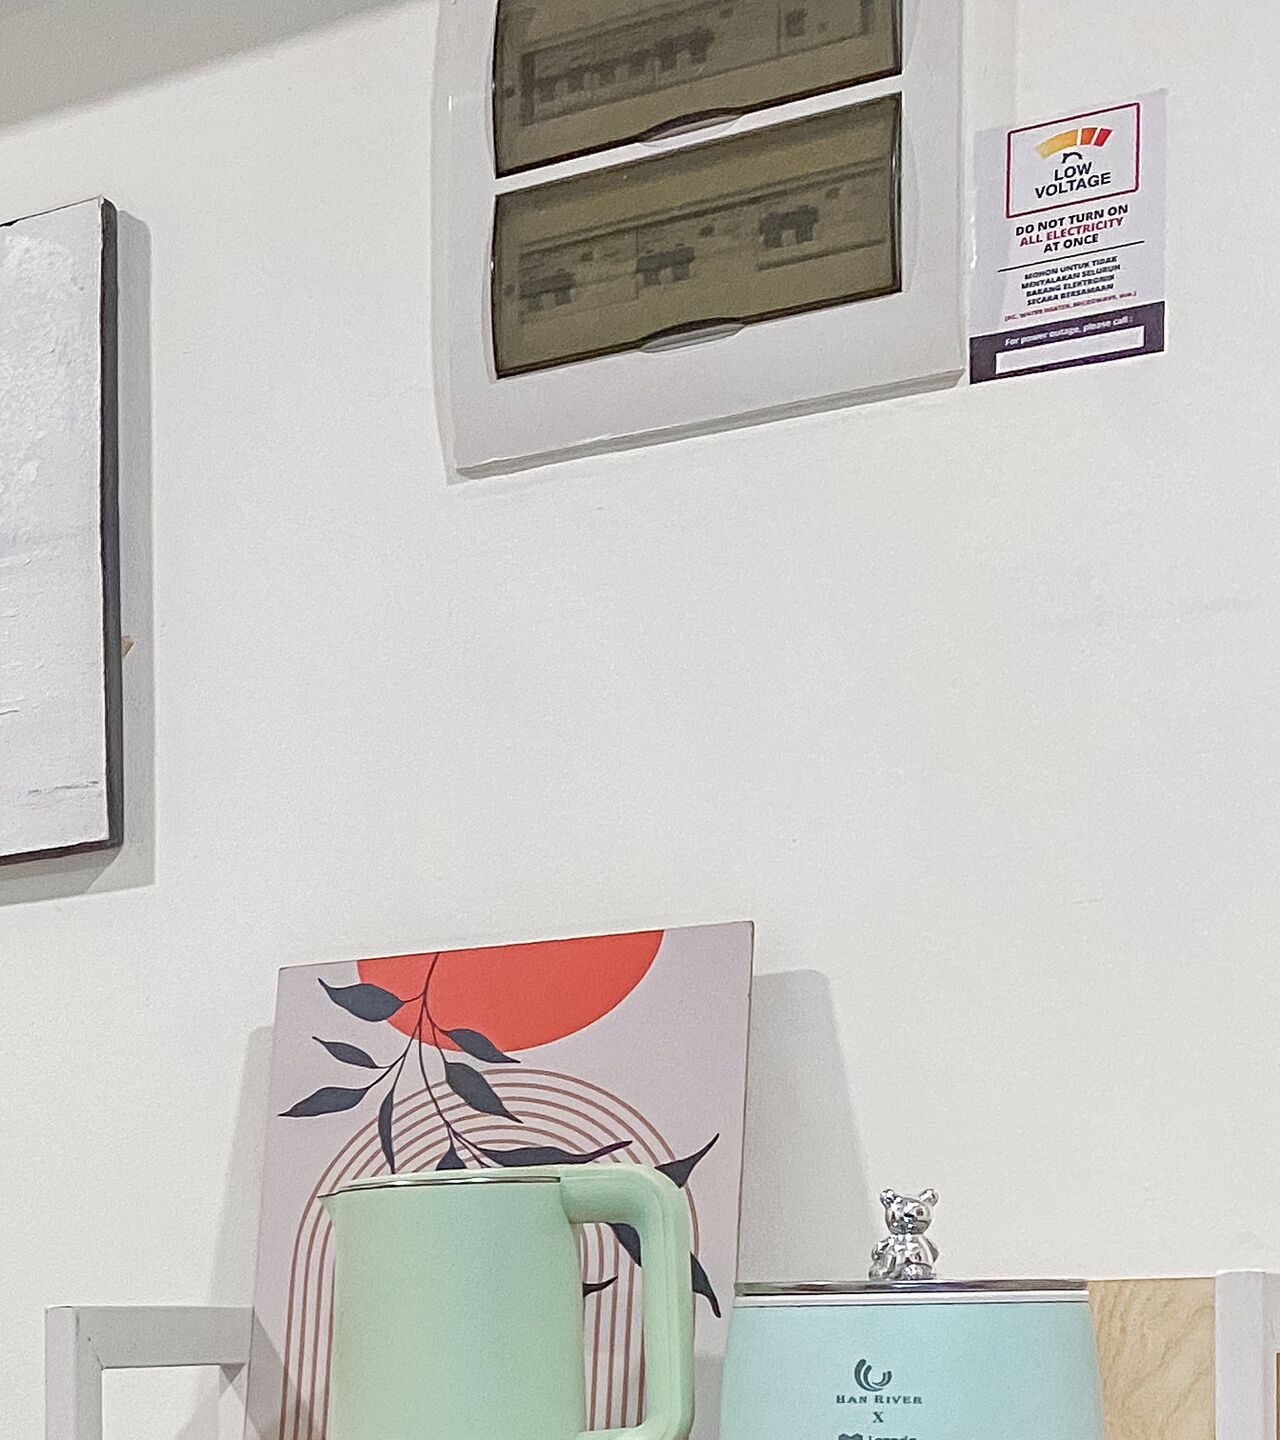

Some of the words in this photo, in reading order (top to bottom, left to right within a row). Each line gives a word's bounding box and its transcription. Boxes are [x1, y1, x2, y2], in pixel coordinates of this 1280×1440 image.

[1054, 162, 1092, 181] LOW
[1035, 172, 1111, 199] VOLTAGE
[1015, 224, 1035, 236] DO
[1038, 217, 1066, 232] NOT
[1068, 209, 1104, 225] TURN
[1107, 204, 1128, 217] ON
[1020, 234, 1043, 247] ALL
[1046, 217, 1124, 241] ELECTRICITY
[1043, 242, 1061, 254] AT
[1063, 234, 1099, 249] ONCE
[1060, 263, 1090, 273] UNTUK
[1005, 338, 1021, 346] For
